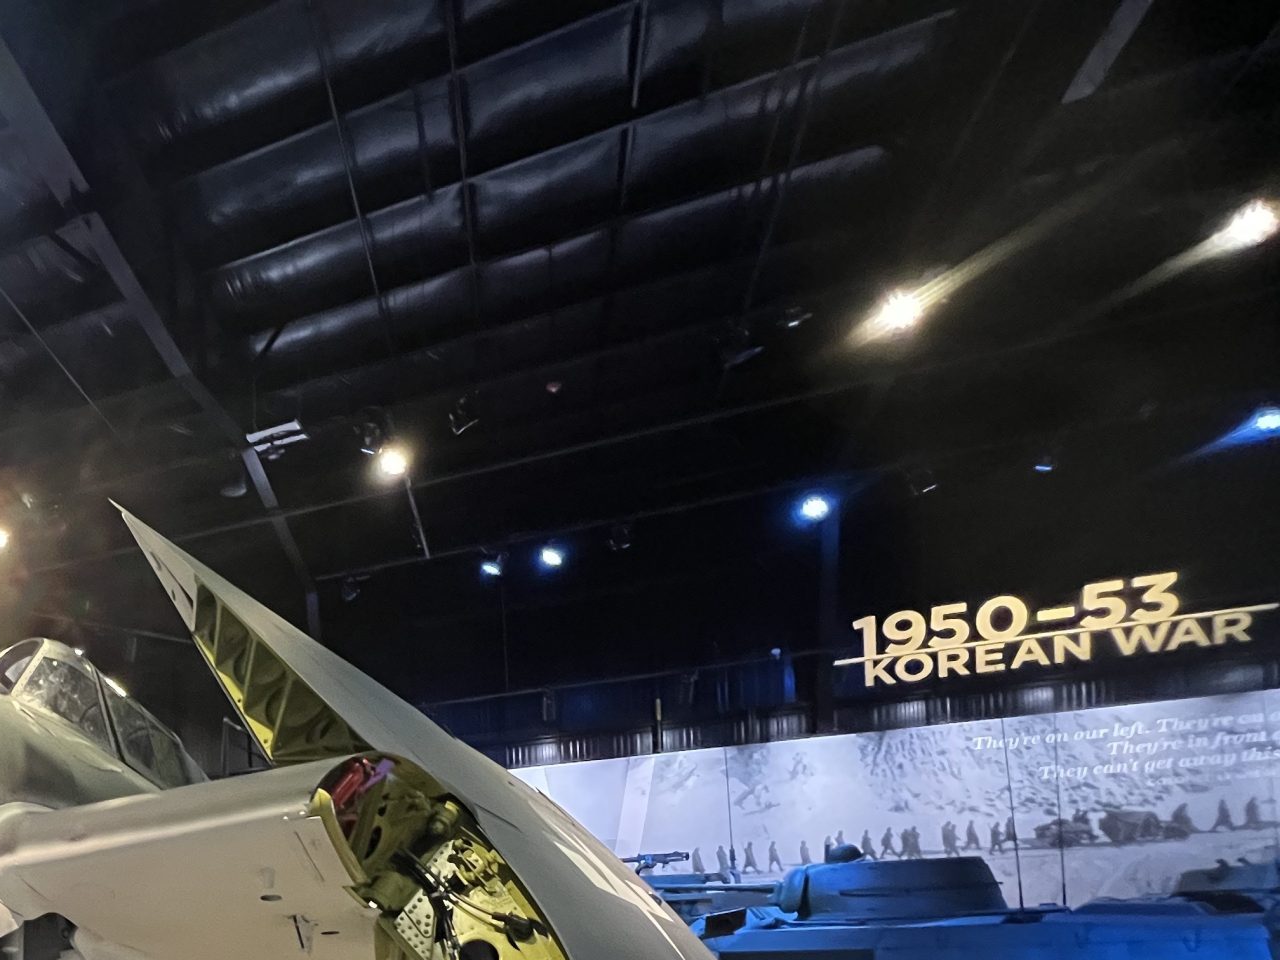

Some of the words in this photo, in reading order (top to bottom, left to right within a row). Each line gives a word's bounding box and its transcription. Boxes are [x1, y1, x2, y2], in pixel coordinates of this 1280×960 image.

[852, 571, 1180, 660] 1950-53
[864, 633, 1092, 687] KOREAN
[1110, 611, 1254, 657] WAR
[972, 732, 1041, 751] They're
[1045, 732, 1069, 745] on
[1074, 728, 1110, 741] our
[1112, 721, 1153, 739] left.
[1106, 738, 1185, 756] They're
[1187, 734, 1209, 749] in
[1209, 731, 1267, 750] front
[1039, 764, 1088, 780] They
[1092, 758, 1140, 775] can't
[1144, 757, 1174, 774] get
[1178, 753, 1237, 768] away
